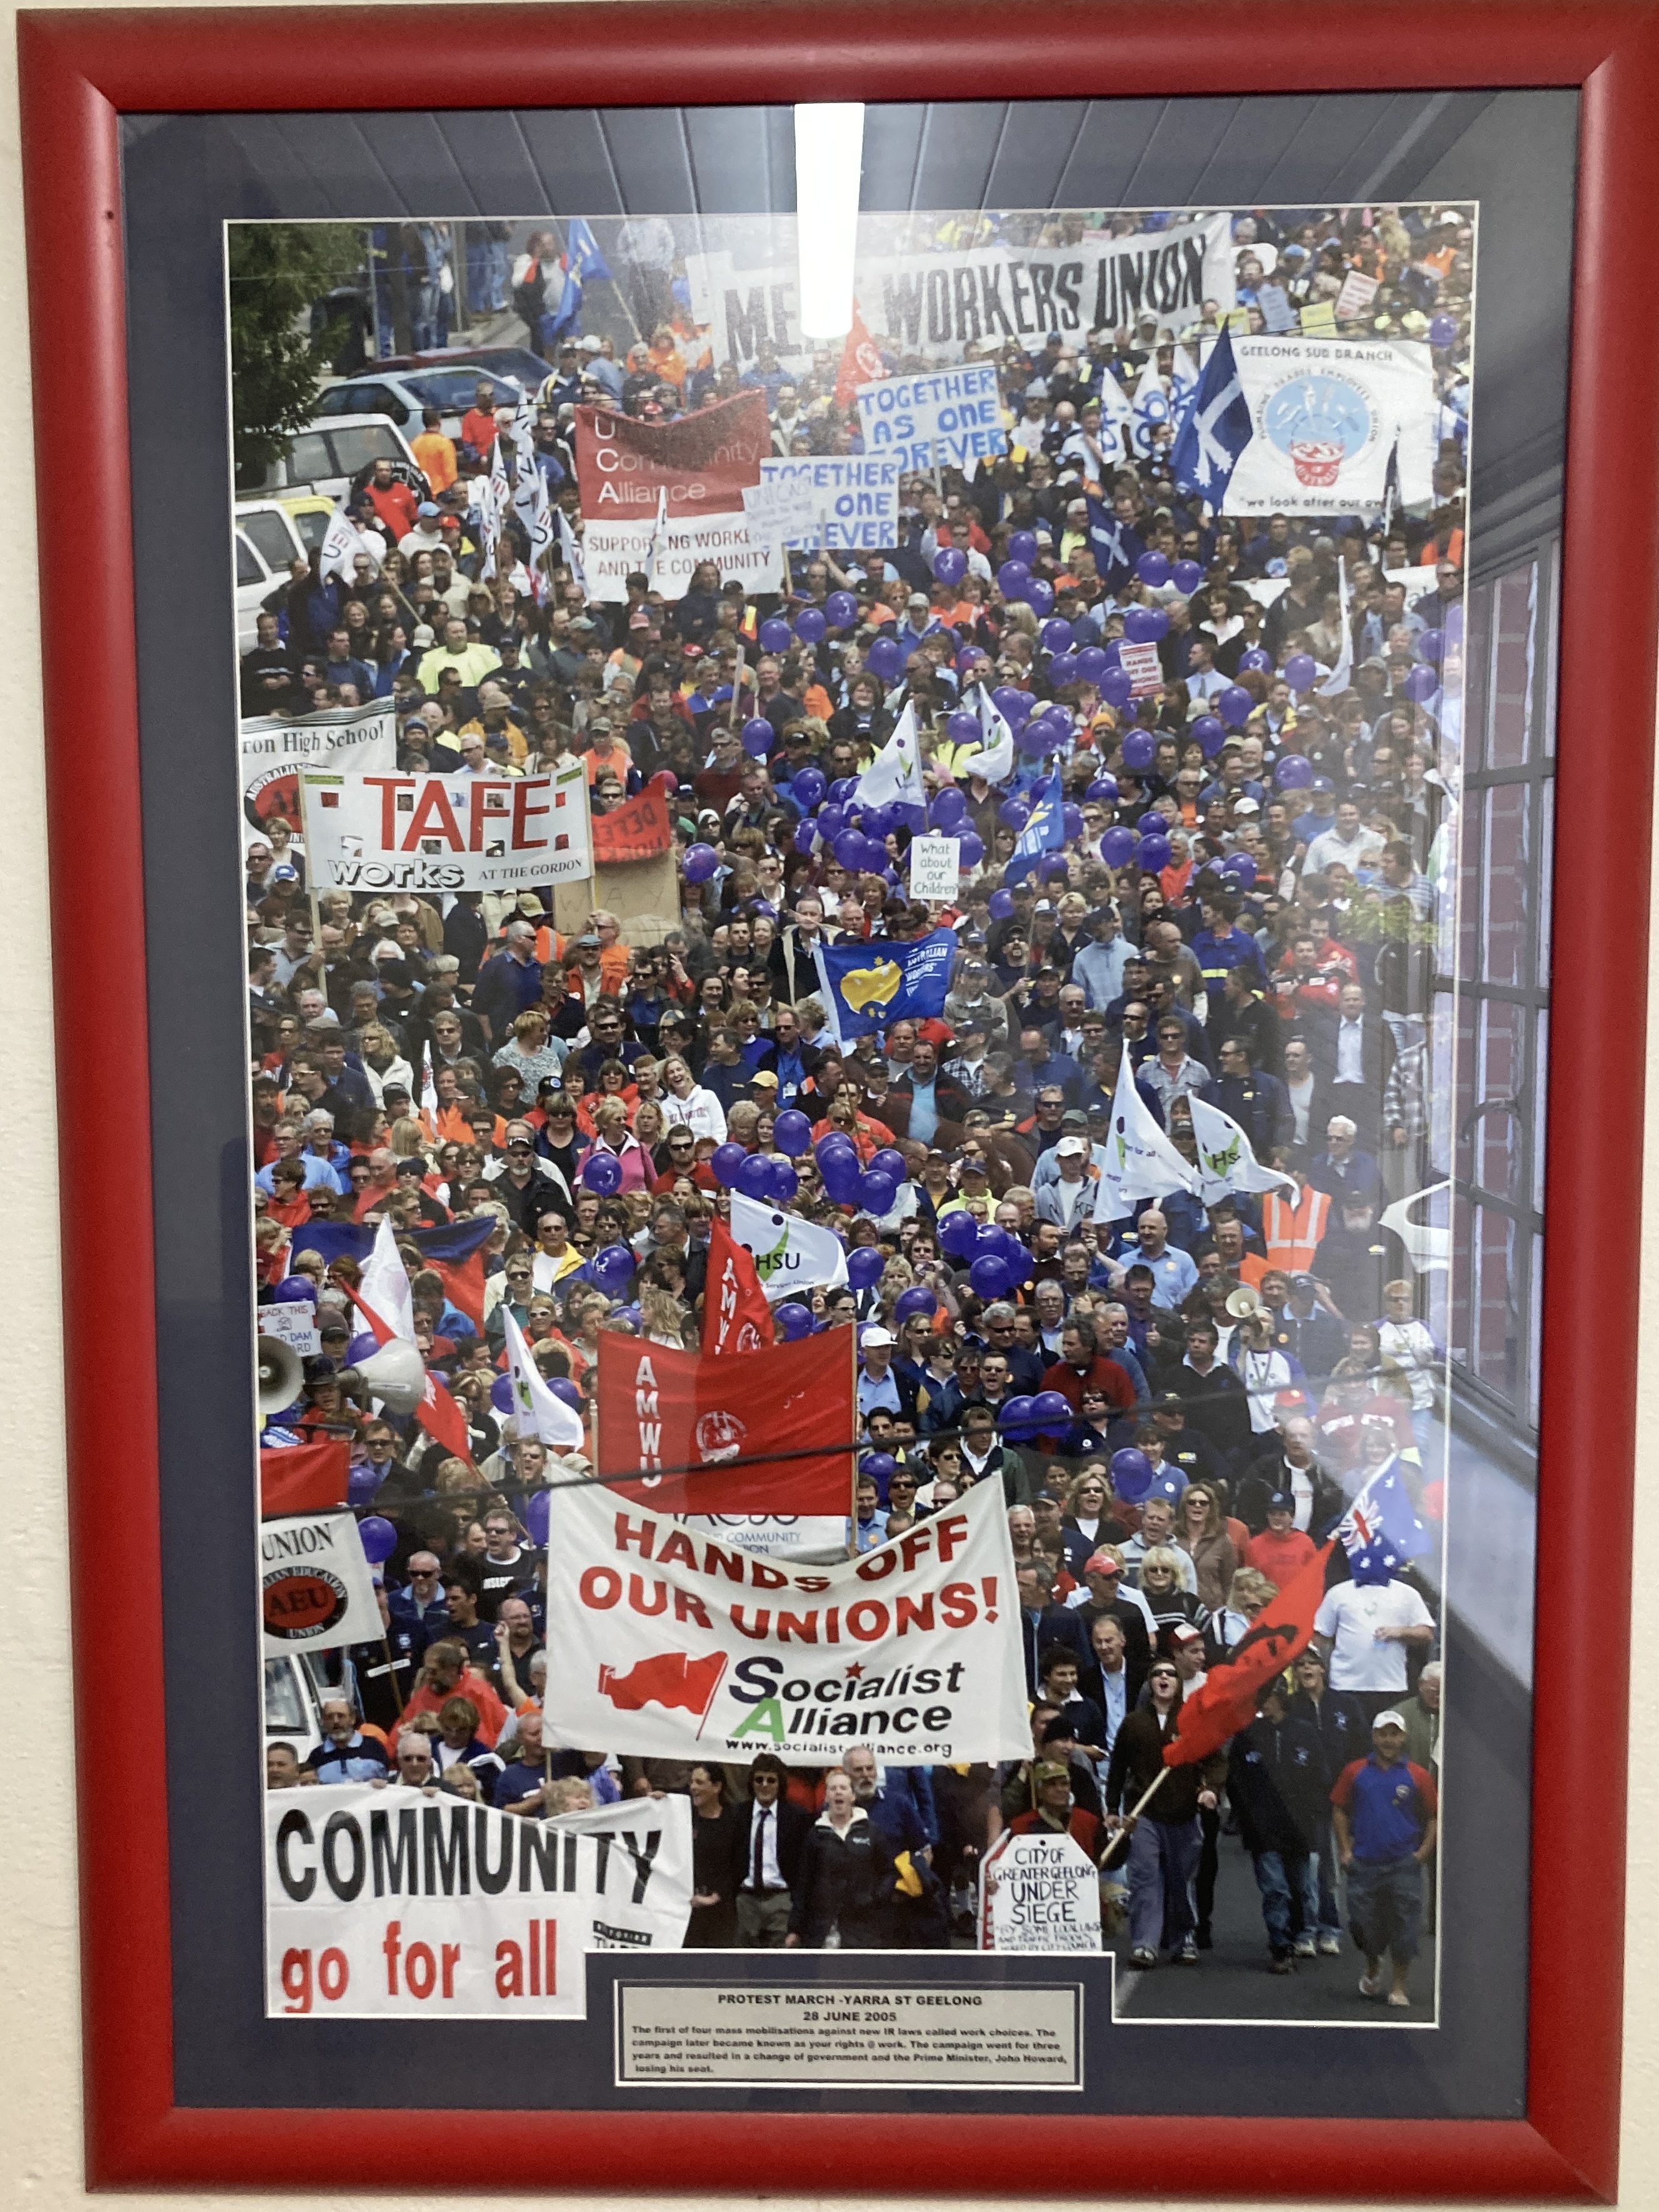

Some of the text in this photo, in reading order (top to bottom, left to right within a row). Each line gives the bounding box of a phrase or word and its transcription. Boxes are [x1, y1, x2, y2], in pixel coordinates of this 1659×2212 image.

[882, 261, 1083, 345] WORKERS
[1094, 233, 1207, 329] UNION
[1240, 346, 1393, 361] GEELONG SUB BRANCH
[858, 369, 997, 417] TOGETHER
[873, 414, 915, 445] AS
[870, 429, 1006, 471] OREVER
[761, 463, 897, 488] TOGETHER
[598, 481, 706, 504] Alliance
[589, 528, 749, 551] SUPPORNG WORKE
[786, 521, 895, 550] EVER
[598, 560, 629, 576] AND
[635, 559, 666, 576] TE
[283, 731, 320, 757] High
[326, 720, 384, 751] School
[246, 764, 299, 801] AUSTRALIA
[363, 776, 551, 852] TAFE
[920, 842, 950, 854] What
[327, 858, 582, 889] works AT THE GORDON
[920, 856, 952, 868] about
[926, 871, 946, 880] our
[1212, 1150, 1241, 1169] HS
[755, 1253, 801, 1271] HSU
[288, 1305, 308, 1315] THIS
[289, 1331, 313, 1342] DAM
[262, 1523, 334, 1561] UNION
[726, 1532, 801, 1543] COMMUNITY
[614, 1511, 970, 1593] HANDS OFF
[270, 1585, 330, 1619] AEU
[579, 1565, 1000, 1644] OUR UNIONS!
[729, 1656, 965, 1704] Socialist
[729, 1697, 952, 1743] Alliance
[726, 1739, 953, 1758] www.socialistiance.org
[276, 1805, 663, 1904] COMMUNITY
[1015, 1847, 1066, 1864] CITY OF
[993, 1866, 1049, 1881] GREATER
[1011, 1881, 1080, 1903] UNDER
[1011, 1901, 1076, 1924] SIEGE
[281, 1918, 558, 2014] go for all
[718, 1994, 781, 2004] PROTEST
[785, 1995, 835, 2004] MARCH
[895, 1996, 912, 2005] ST
[916, 1996, 983, 2005] GEELONG
[803, 2011, 897, 2021] 28 JUNE 2005
[631, 2025, 651, 2033] The
[654, 2025, 676, 2033] first
[746, 2026, 814, 2034] mobilisations
[818, 2027, 856, 2036] against
[898, 2028, 922, 2036] laws
[989, 2028, 1033, 2036] choices.
[1036, 2028, 1056, 2036] The
[631, 2039, 683, 2048] campaign
[808, 2041, 831, 2049] your
[835, 2040, 865, 2049] rights
[910, 2040, 930, 2048] The
[932, 2041, 983, 2049] campaign
[635, 2064, 666, 2073] losing
[688, 2064, 714, 2073] seat.
[753, 2053, 791, 2062] change
[807, 2054, 868, 2062] government
[946, 2054, 992, 2063] Minister,
[995, 2054, 1021, 2062] John
[1023, 2054, 1067, 2064] Howard,
